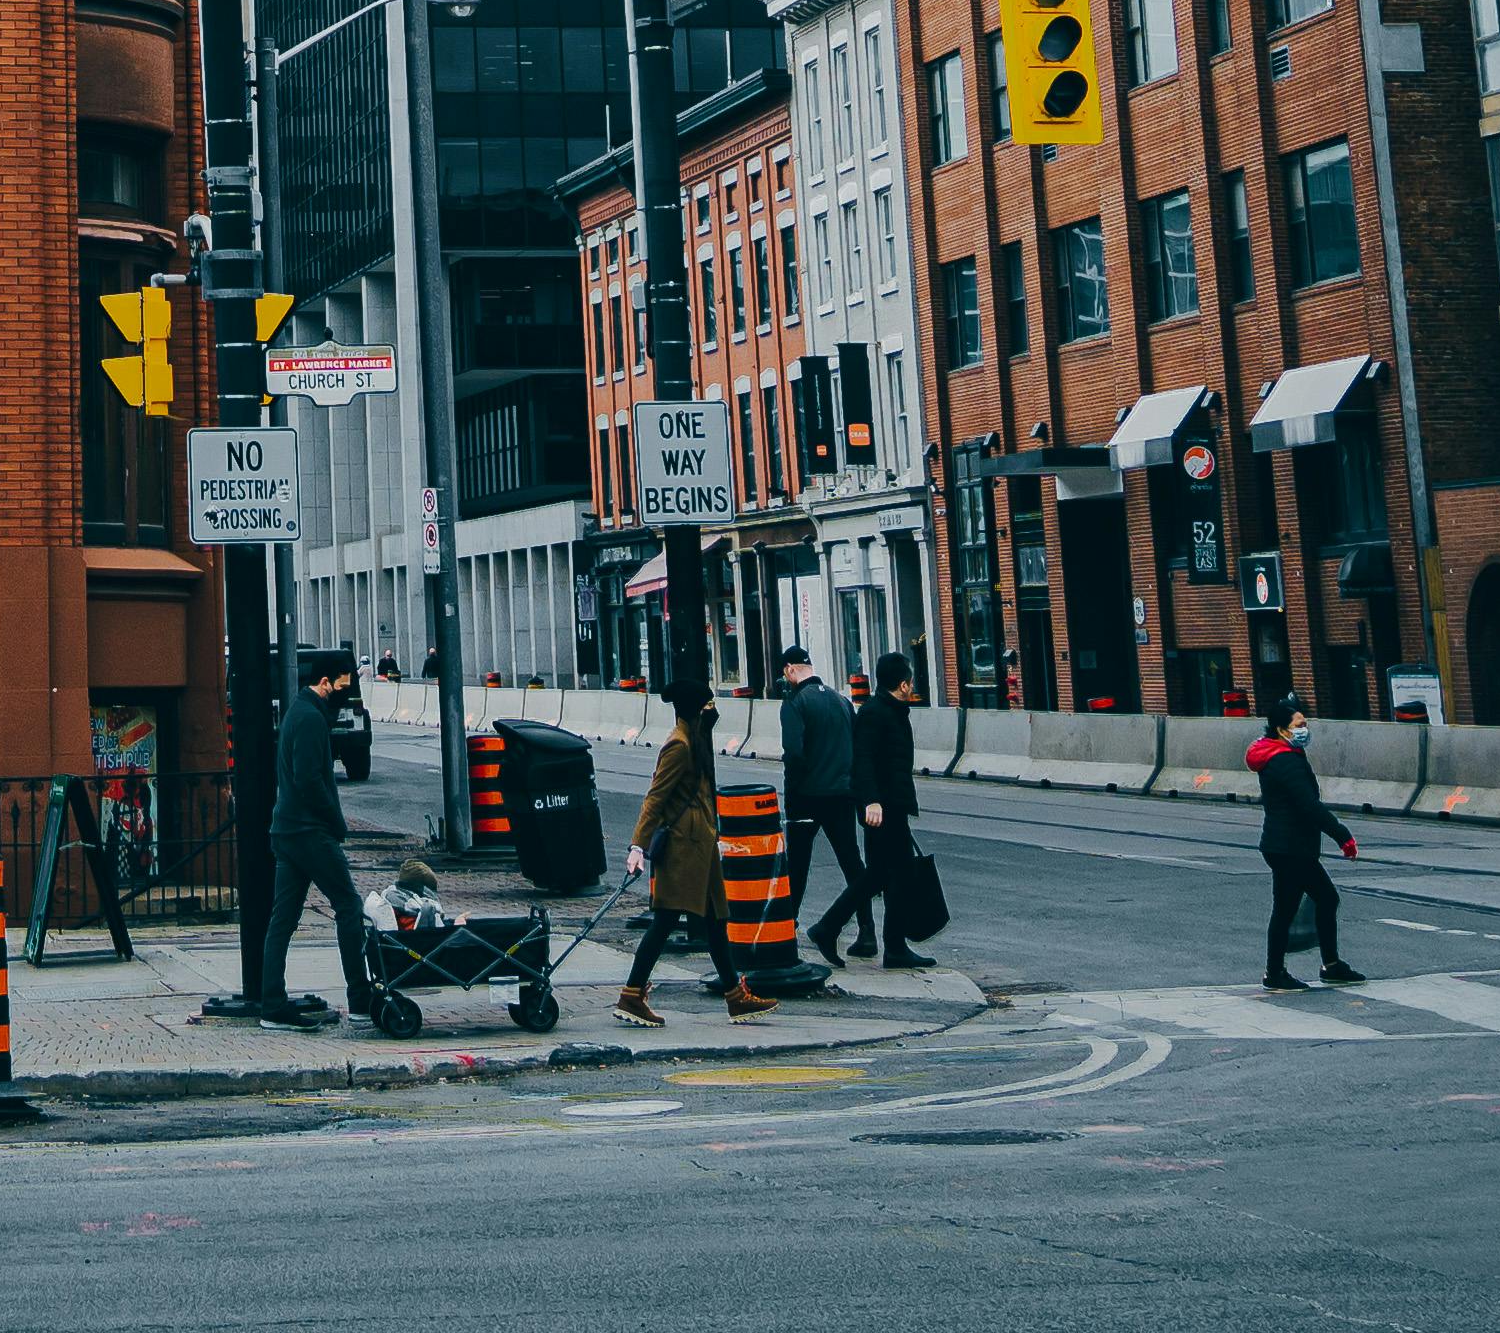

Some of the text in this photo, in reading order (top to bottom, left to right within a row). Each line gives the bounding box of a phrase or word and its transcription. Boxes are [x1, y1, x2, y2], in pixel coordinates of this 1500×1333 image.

[292, 360, 345, 370] LAWRENCE
[348, 359, 388, 369] MARKET
[288, 373, 345, 389] CHURCH
[659, 412, 706, 439] ONE
[226, 440, 263, 472] NO
[661, 448, 706, 476] WAY
[644, 485, 728, 514] BEGINS
[1193, 521, 1216, 543] 52
[96, 752, 151, 769] TISH PUB
[546, 794, 569, 808] Litter
